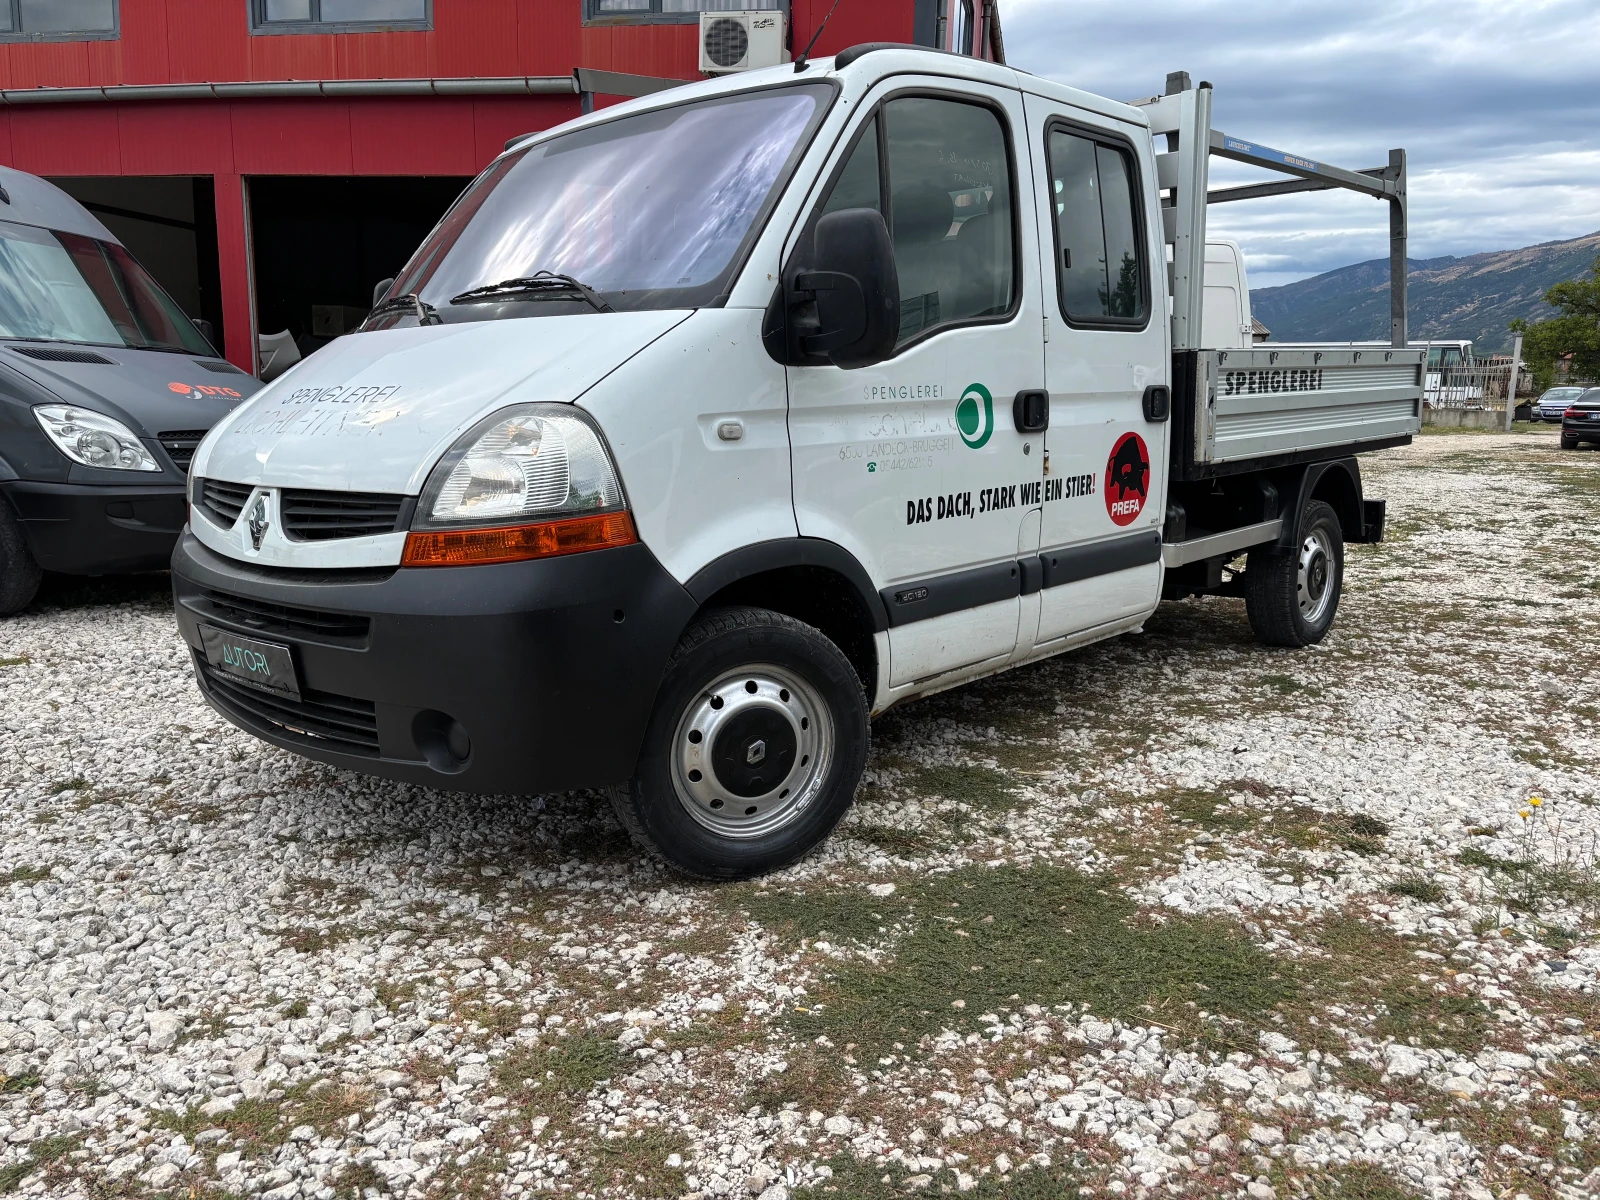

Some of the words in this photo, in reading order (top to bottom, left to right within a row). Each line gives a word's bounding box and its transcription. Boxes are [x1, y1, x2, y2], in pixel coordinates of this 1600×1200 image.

[195, 385, 242, 397] DTG
[1224, 369, 1322, 396] SPENGLEREI
[281, 385, 401, 404] SPENGLEREI
[863, 385, 944, 400] SPENGLEREI
[906, 497, 932, 525] DAS
[937, 492, 975, 519] DACH,
[979, 485, 1016, 513] STARK
[1020, 481, 1041, 506] WIE
[1044, 478, 1063, 501] EIN
[1065, 473, 1096, 498] STIER!
[1111, 499, 1140, 516] PREFA
